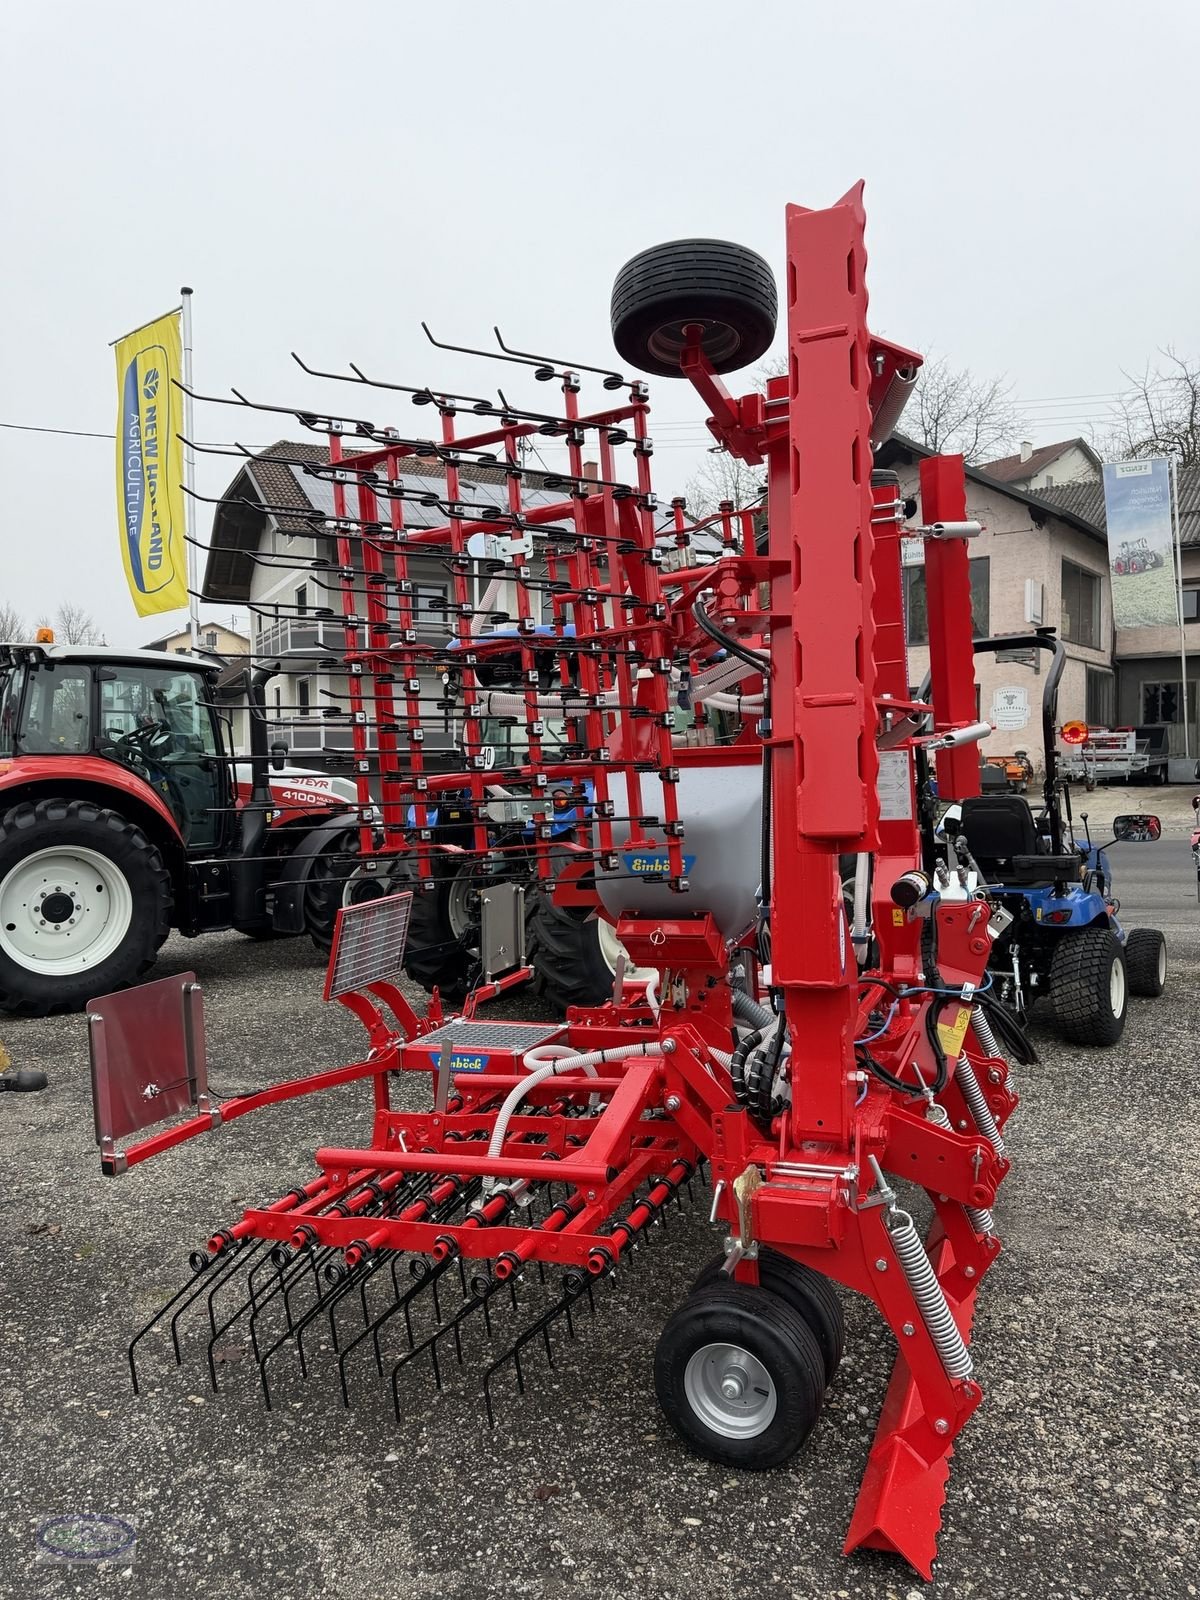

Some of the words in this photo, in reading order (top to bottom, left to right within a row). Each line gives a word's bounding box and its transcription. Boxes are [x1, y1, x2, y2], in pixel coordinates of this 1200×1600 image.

[144, 405, 159, 459] NEW
[127, 412, 142, 537] AGRICULTURE
[145, 463, 163, 571] HOLLAND
[282, 790, 316, 803] 4100
[290, 777, 329, 789] STEYR
